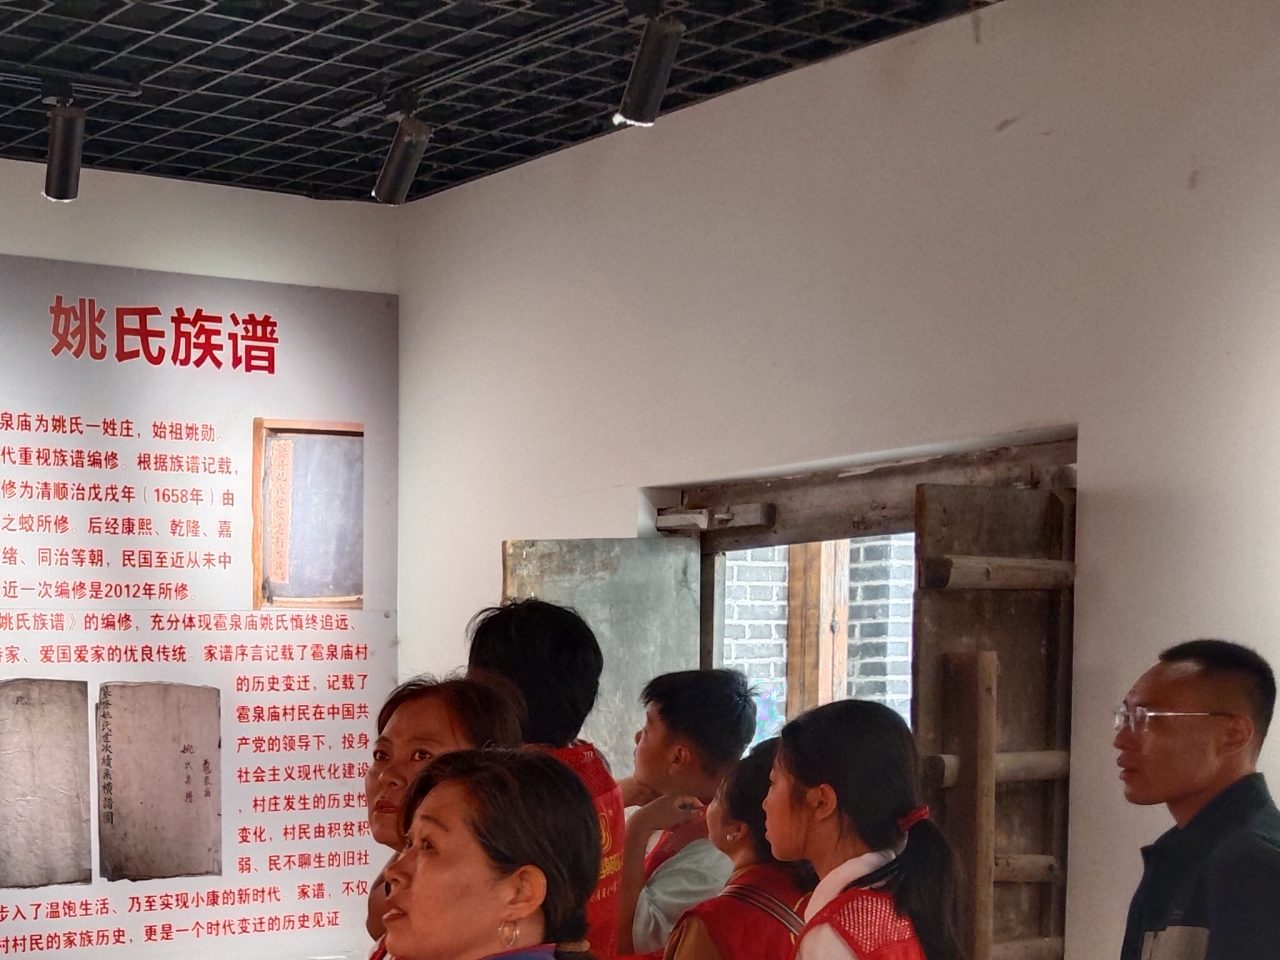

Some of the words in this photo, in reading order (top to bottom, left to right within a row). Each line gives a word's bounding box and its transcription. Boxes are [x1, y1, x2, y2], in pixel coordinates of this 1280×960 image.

[48, 294, 279, 375] 姚氏族谱
[235, 703, 370, 723] 雹泉庙村民在中国共
[236, 763, 370, 784] 社会主义现代化建设
